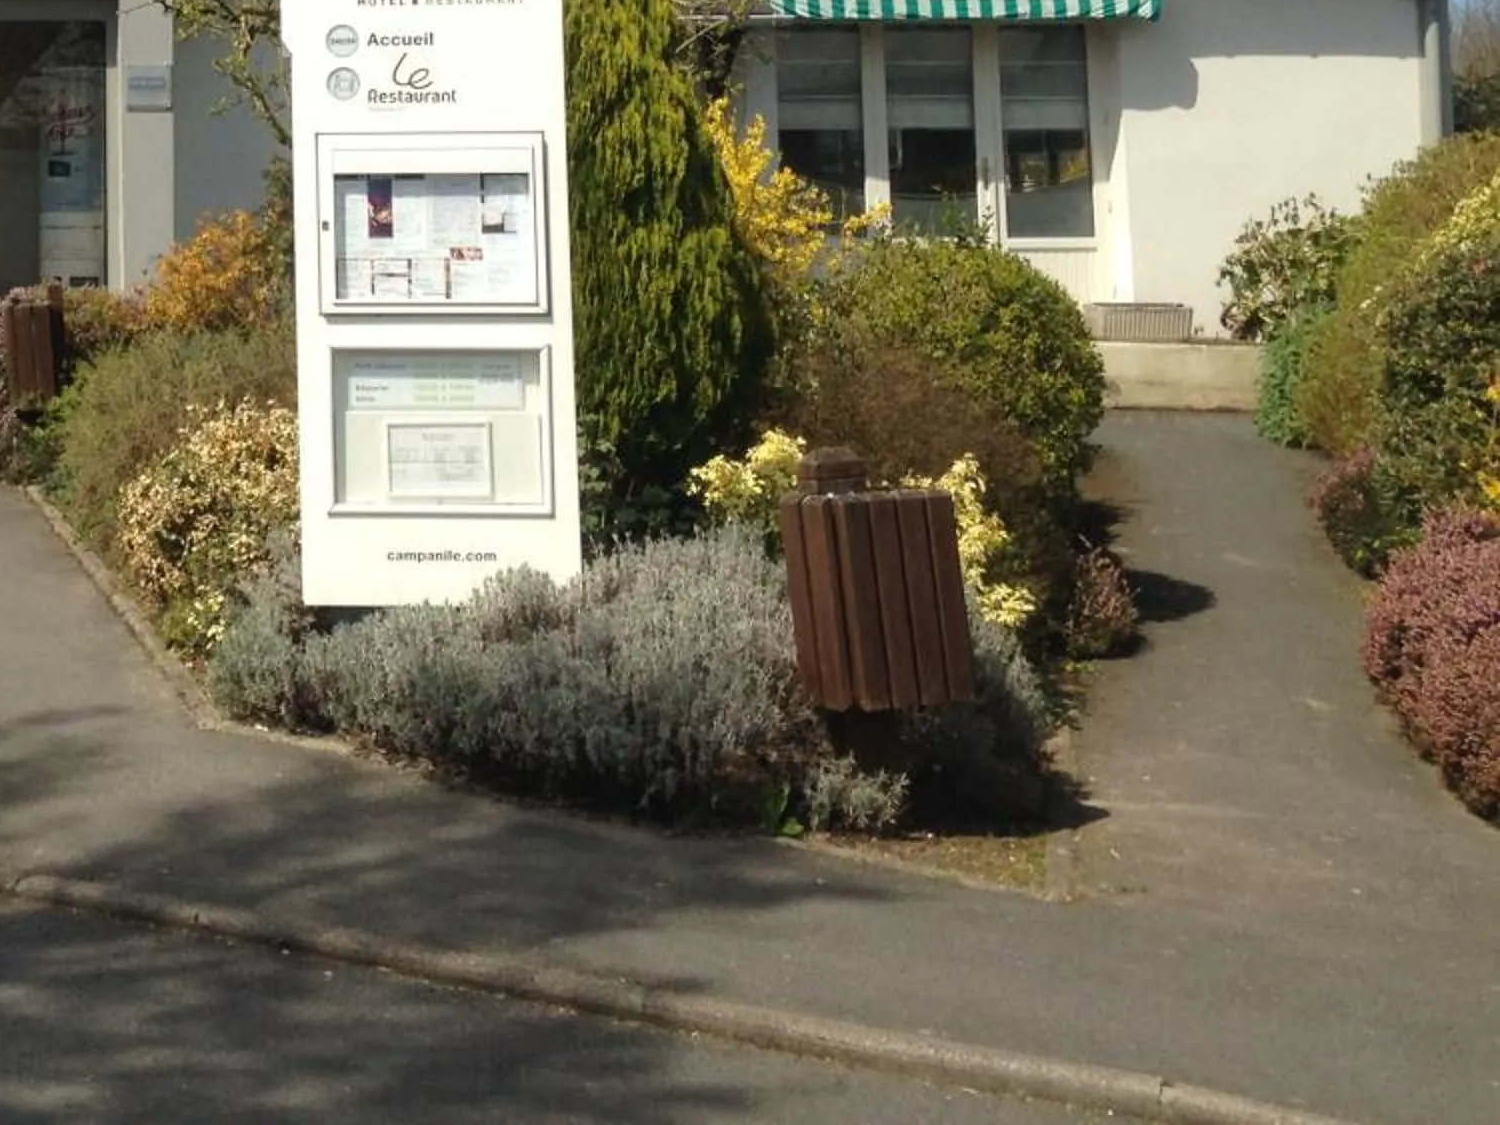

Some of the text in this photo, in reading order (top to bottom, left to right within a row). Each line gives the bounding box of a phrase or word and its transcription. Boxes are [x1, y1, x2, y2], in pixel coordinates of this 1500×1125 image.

[367, 32, 434, 46] Accueil
[392, 52, 434, 90] Le
[367, 88, 457, 104] Restaurant
[387, 549, 497, 563] campanile.com
